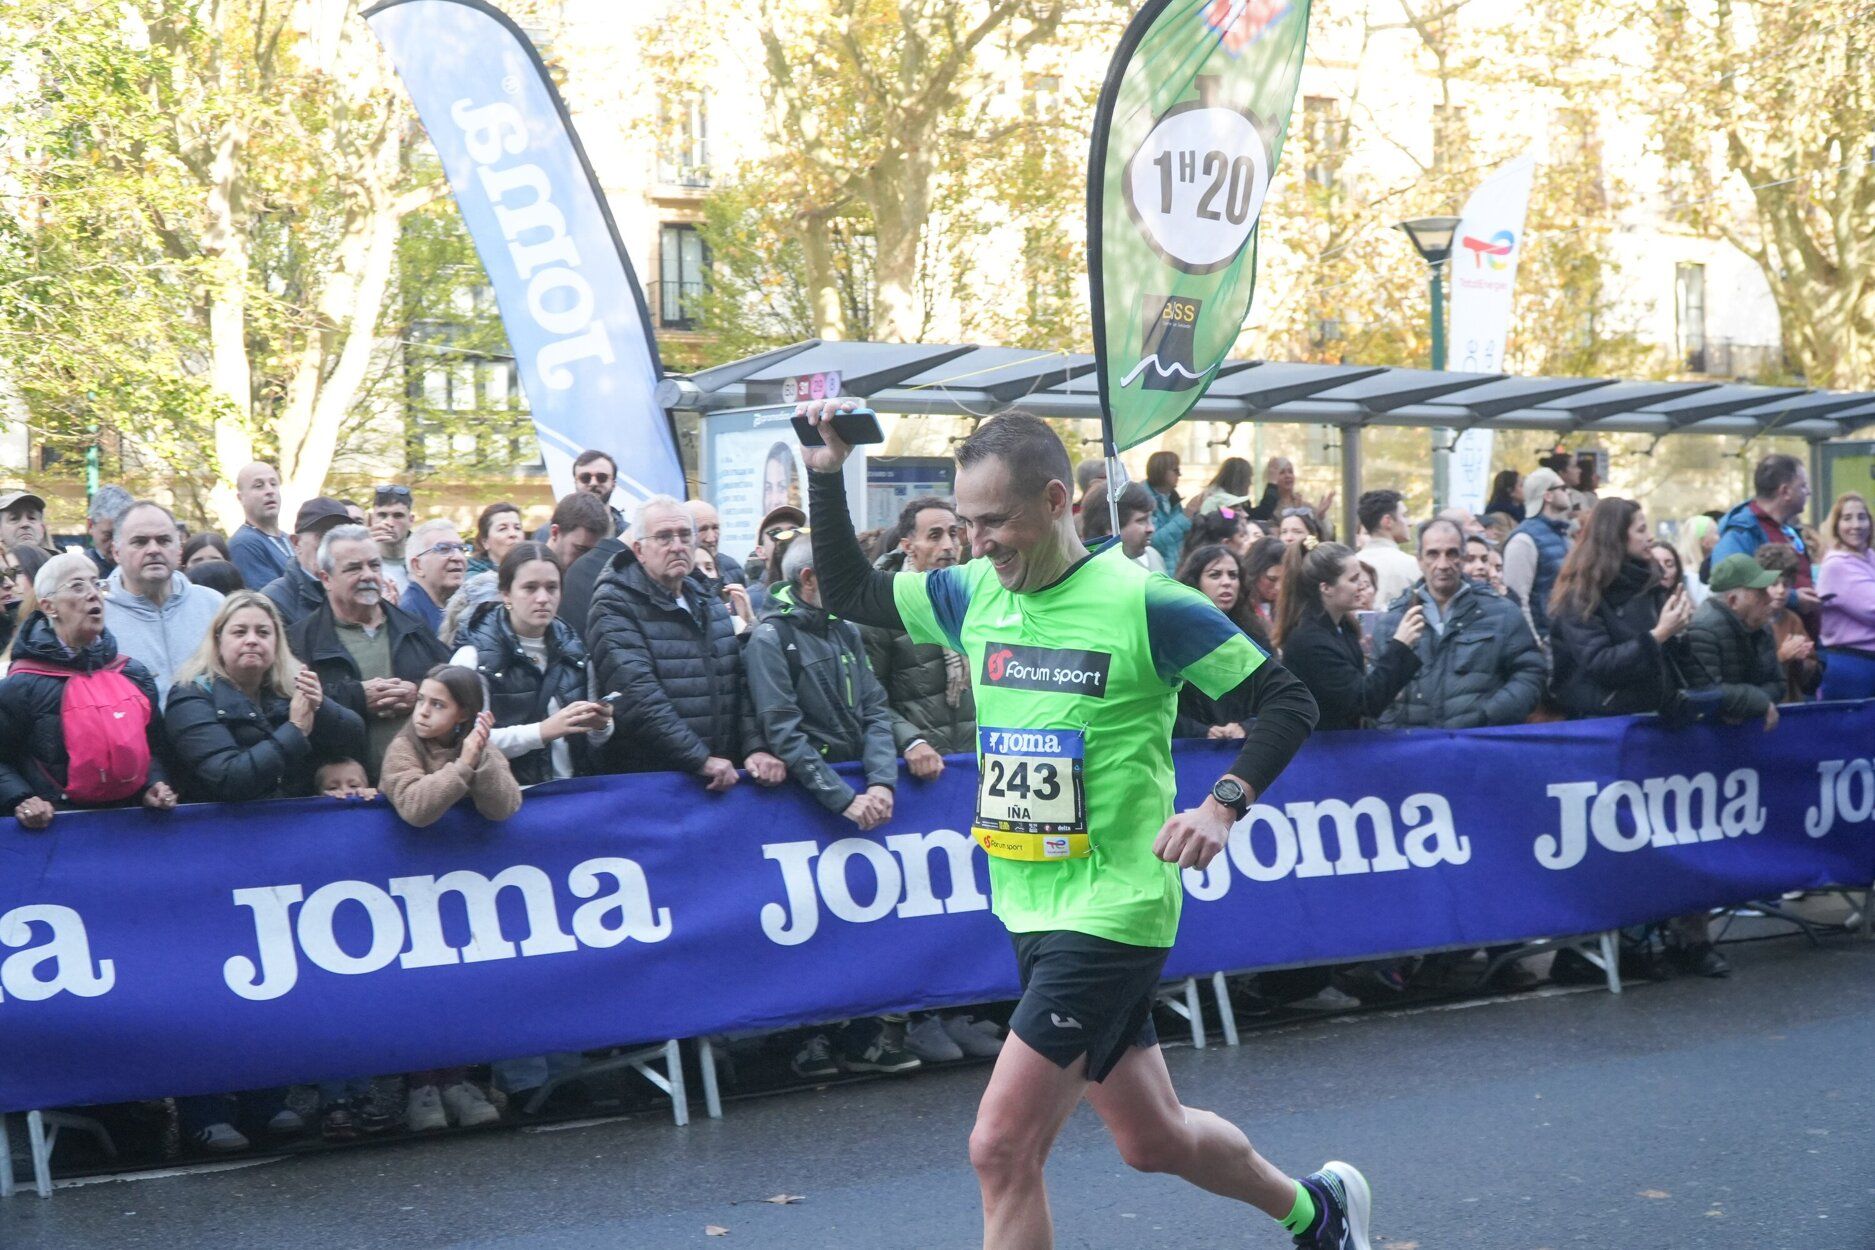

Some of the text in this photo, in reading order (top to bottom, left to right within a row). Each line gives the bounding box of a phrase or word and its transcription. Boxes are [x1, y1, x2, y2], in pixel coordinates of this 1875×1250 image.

[1153, 150, 1255, 225] 1H20
[1005, 661, 1101, 686] Forum sport
[988, 760, 1061, 801] 243
[1007, 804, 1032, 820] IÑA
[1804, 758, 1875, 838] Jo
[1534, 767, 1766, 870] Joma
[223, 857, 672, 1001] Joma
